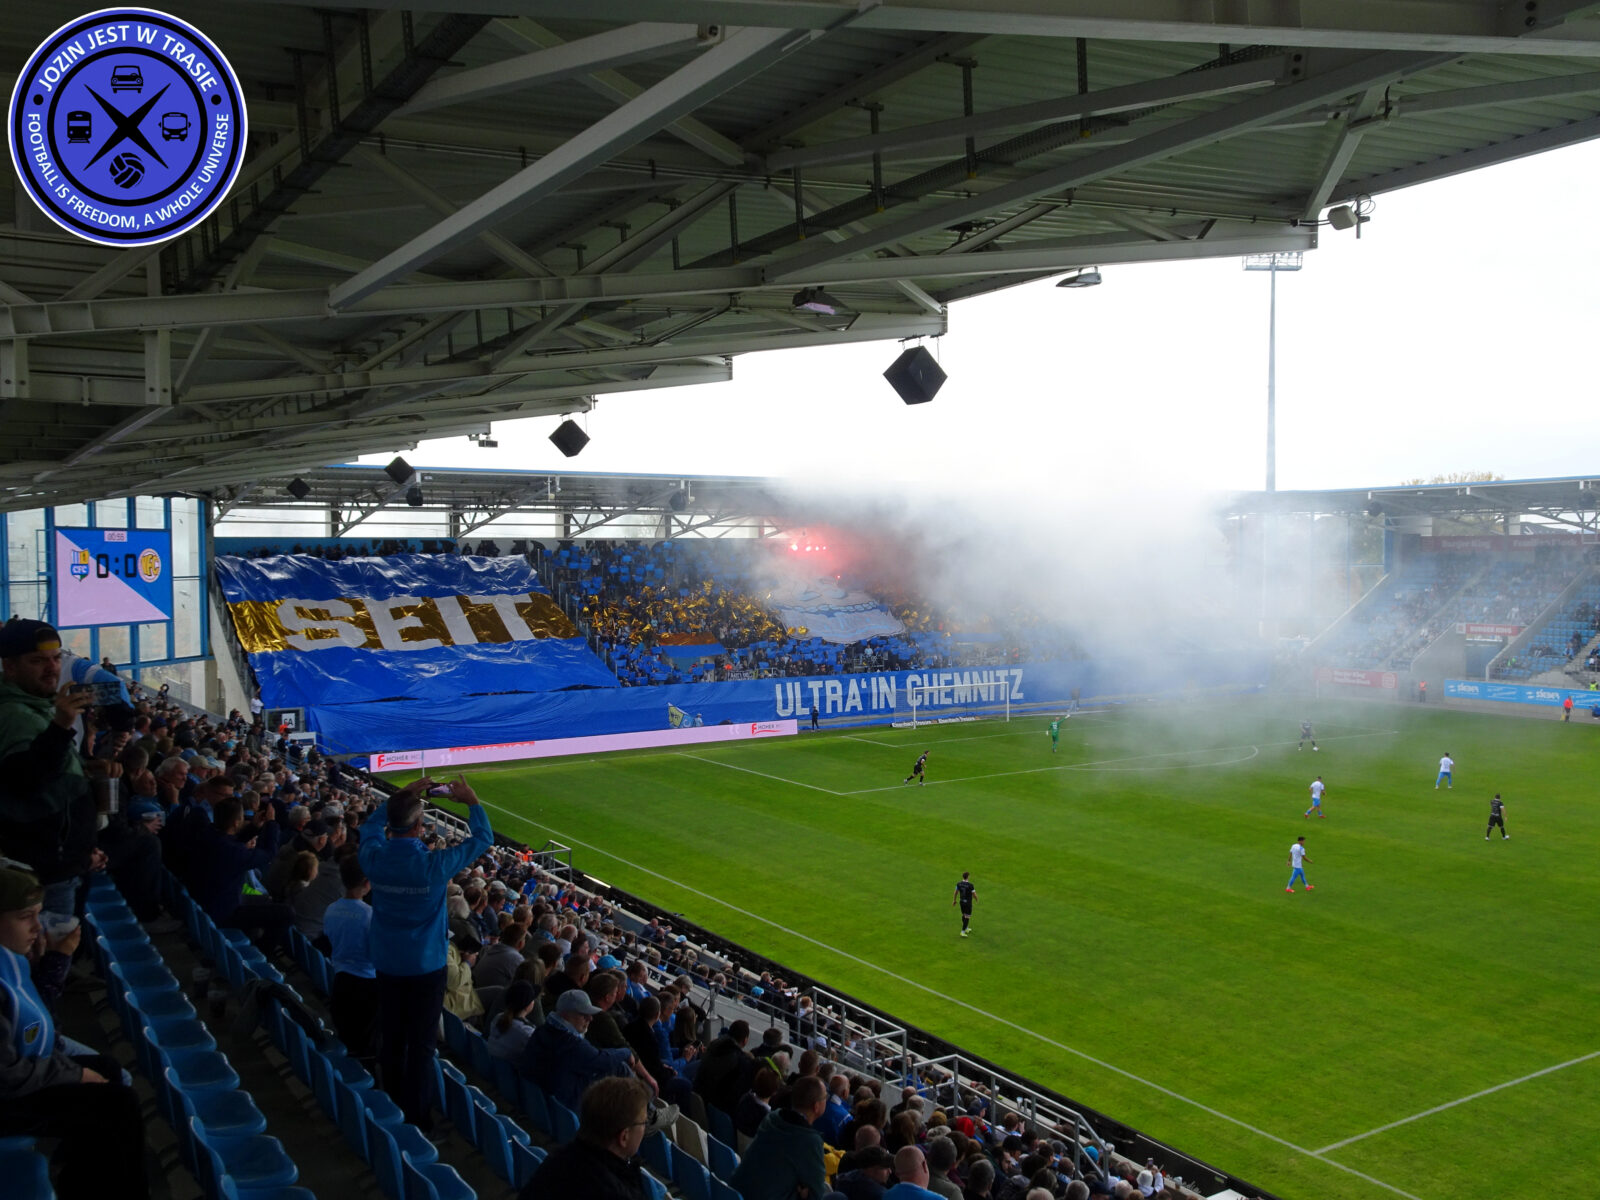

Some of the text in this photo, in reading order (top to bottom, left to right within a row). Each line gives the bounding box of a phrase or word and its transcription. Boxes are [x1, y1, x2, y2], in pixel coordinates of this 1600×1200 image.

[73, 566, 88, 574] CFC
[276, 593, 534, 652] SEIT
[906, 668, 1024, 706] CHEMNITZ
